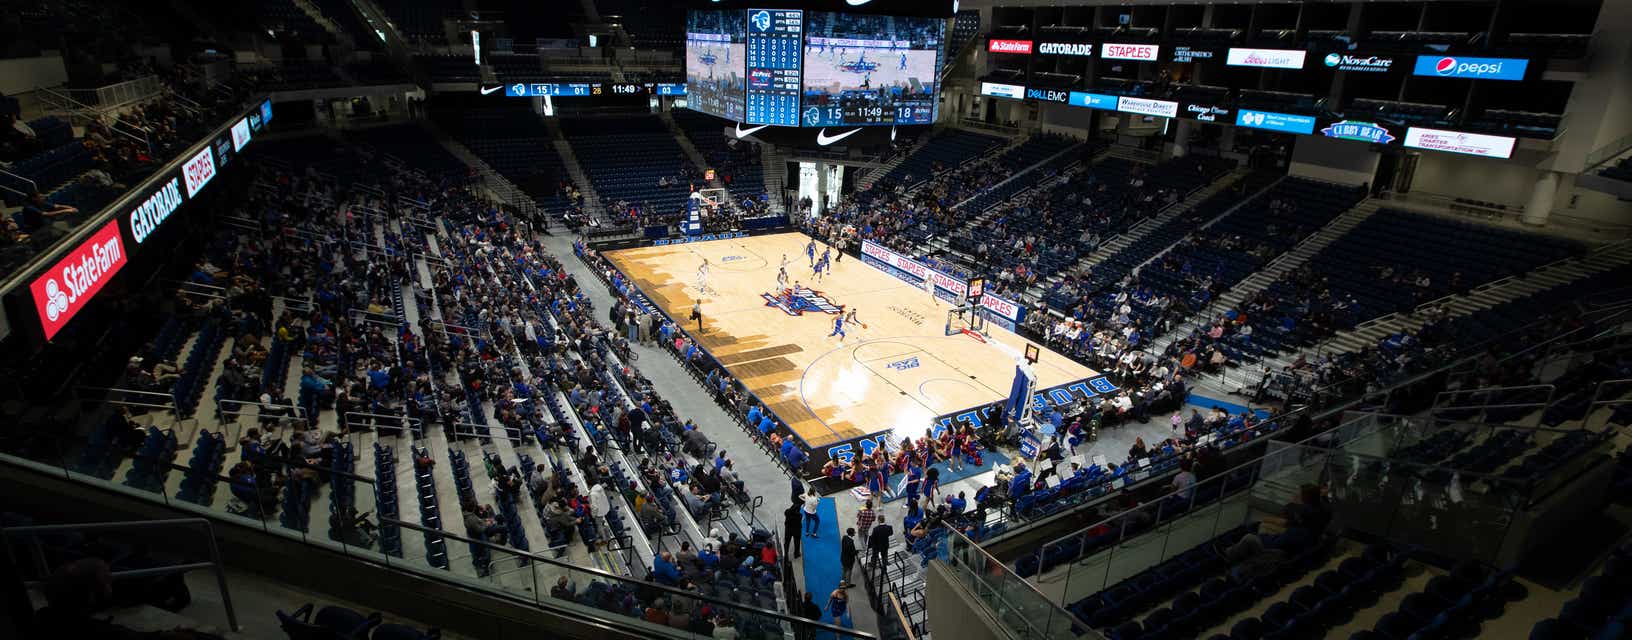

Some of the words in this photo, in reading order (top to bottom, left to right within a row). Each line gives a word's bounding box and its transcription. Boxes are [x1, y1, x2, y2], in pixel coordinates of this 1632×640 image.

[1039, 43, 1093, 56] GATORADE
[1108, 46, 1151, 58] STAPLES
[1457, 61, 1503, 75] pepsi
[536, 86, 547, 94] 15
[613, 85, 635, 93] 11:49
[827, 109, 842, 119] 15
[858, 108, 882, 117] 11:49
[898, 108, 911, 118] 18
[130, 177, 182, 243] GATORADE
[865, 243, 891, 262] STAPLES
[896, 257, 927, 278] STAPLES
[933, 273, 967, 293] STAPLES
[980, 294, 1012, 316] TAPLES
[1032, 376, 1119, 412] BLUE
